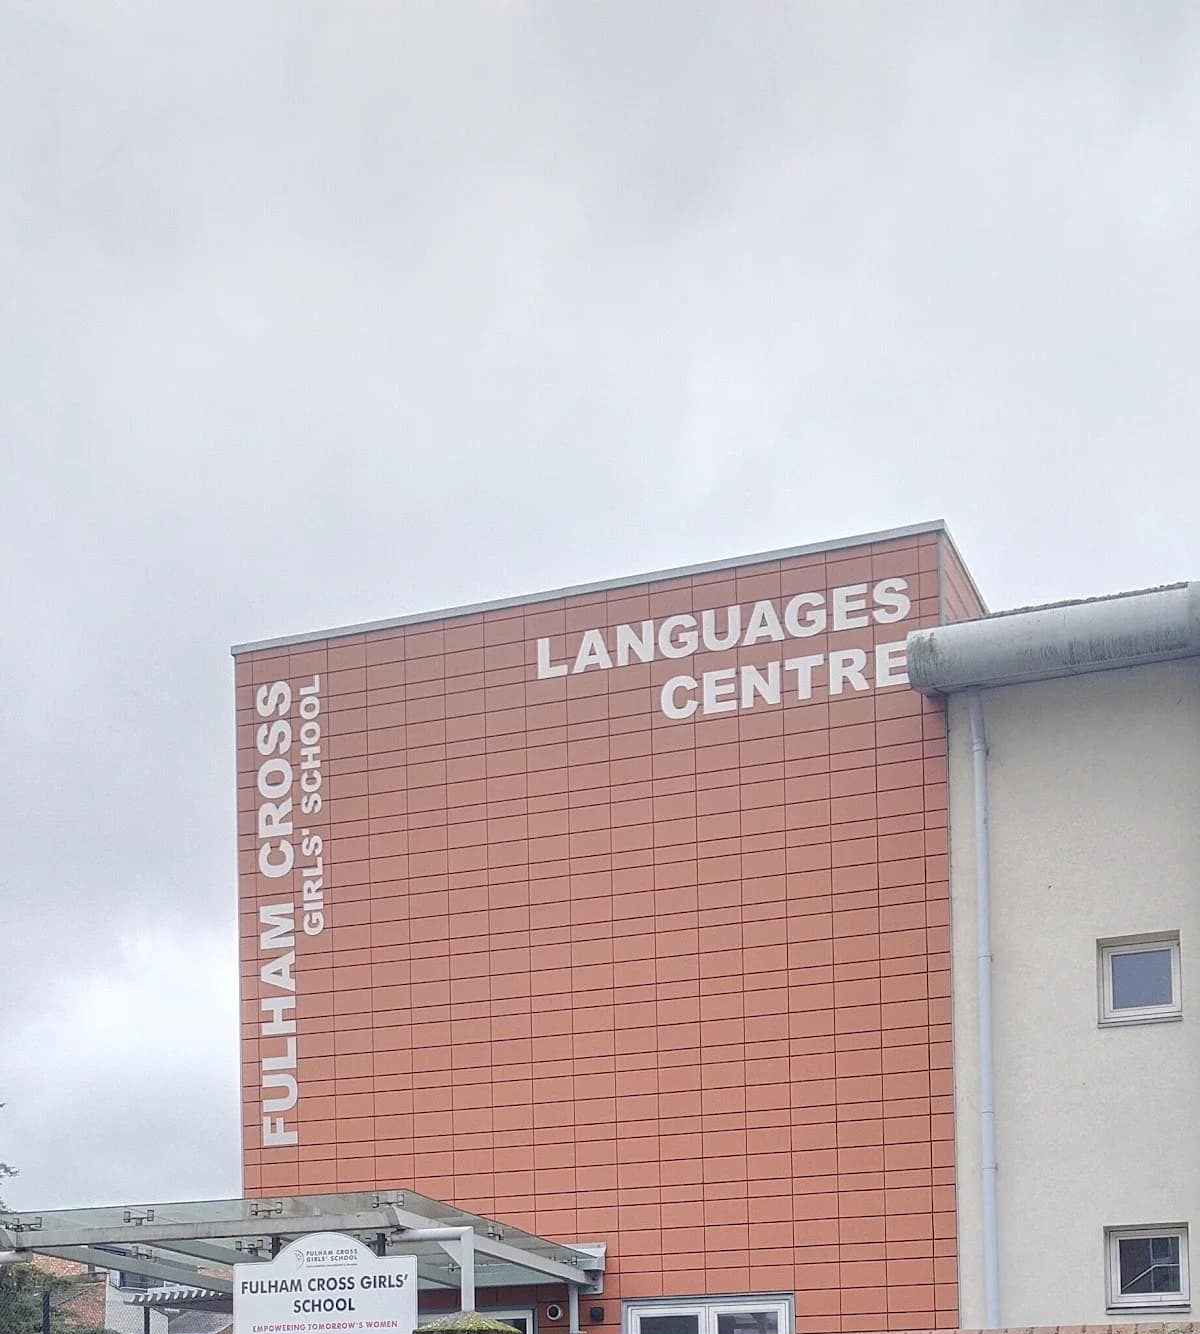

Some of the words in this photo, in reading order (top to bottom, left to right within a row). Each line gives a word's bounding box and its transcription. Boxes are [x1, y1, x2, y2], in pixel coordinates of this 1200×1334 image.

[537, 577, 912, 680] LANGUAGES
[660, 640, 911, 720] CENTRE
[256, 680, 295, 879] CROSS
[300, 674, 323, 815] SCHOOL
[302, 828, 325, 936] GIRLS'
[260, 902, 298, 1147] FULHAM
[241, 1278, 303, 1295] FULHAM
[307, 1277, 355, 1292] CROSS
[360, 1274, 409, 1290] GIRLS'
[252, 1323, 306, 1333] EMPOWERING
[307, 1321, 364, 1331] TOMORROW'S
[366, 1320, 398, 1329] WOMEN
[293, 1298, 356, 1313] SCHOOL
